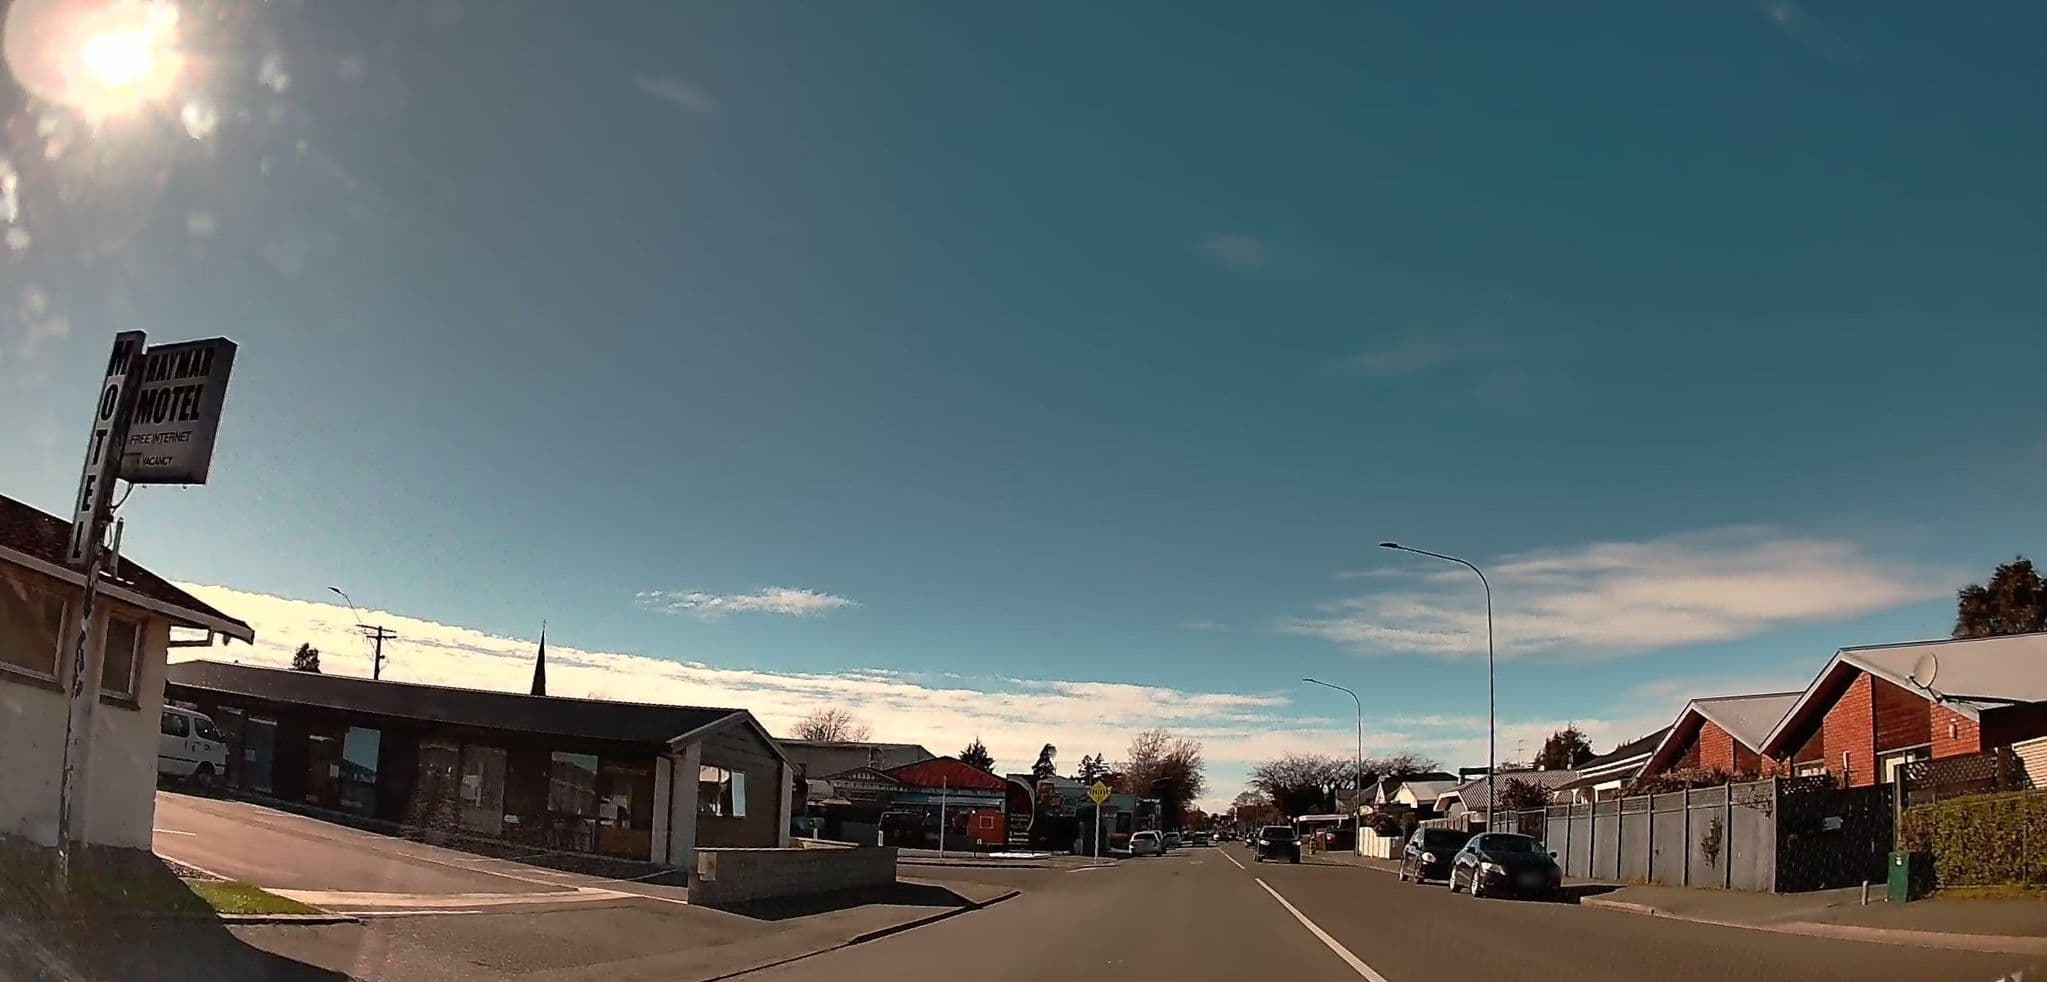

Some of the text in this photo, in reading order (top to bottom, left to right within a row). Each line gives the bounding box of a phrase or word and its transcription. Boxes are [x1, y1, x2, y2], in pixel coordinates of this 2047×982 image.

[133, 384, 204, 424] MOTEL
[72, 340, 134, 558] MOTEL
[129, 430, 193, 445] FREE INTERNET
[142, 456, 174, 466] VACANCY
